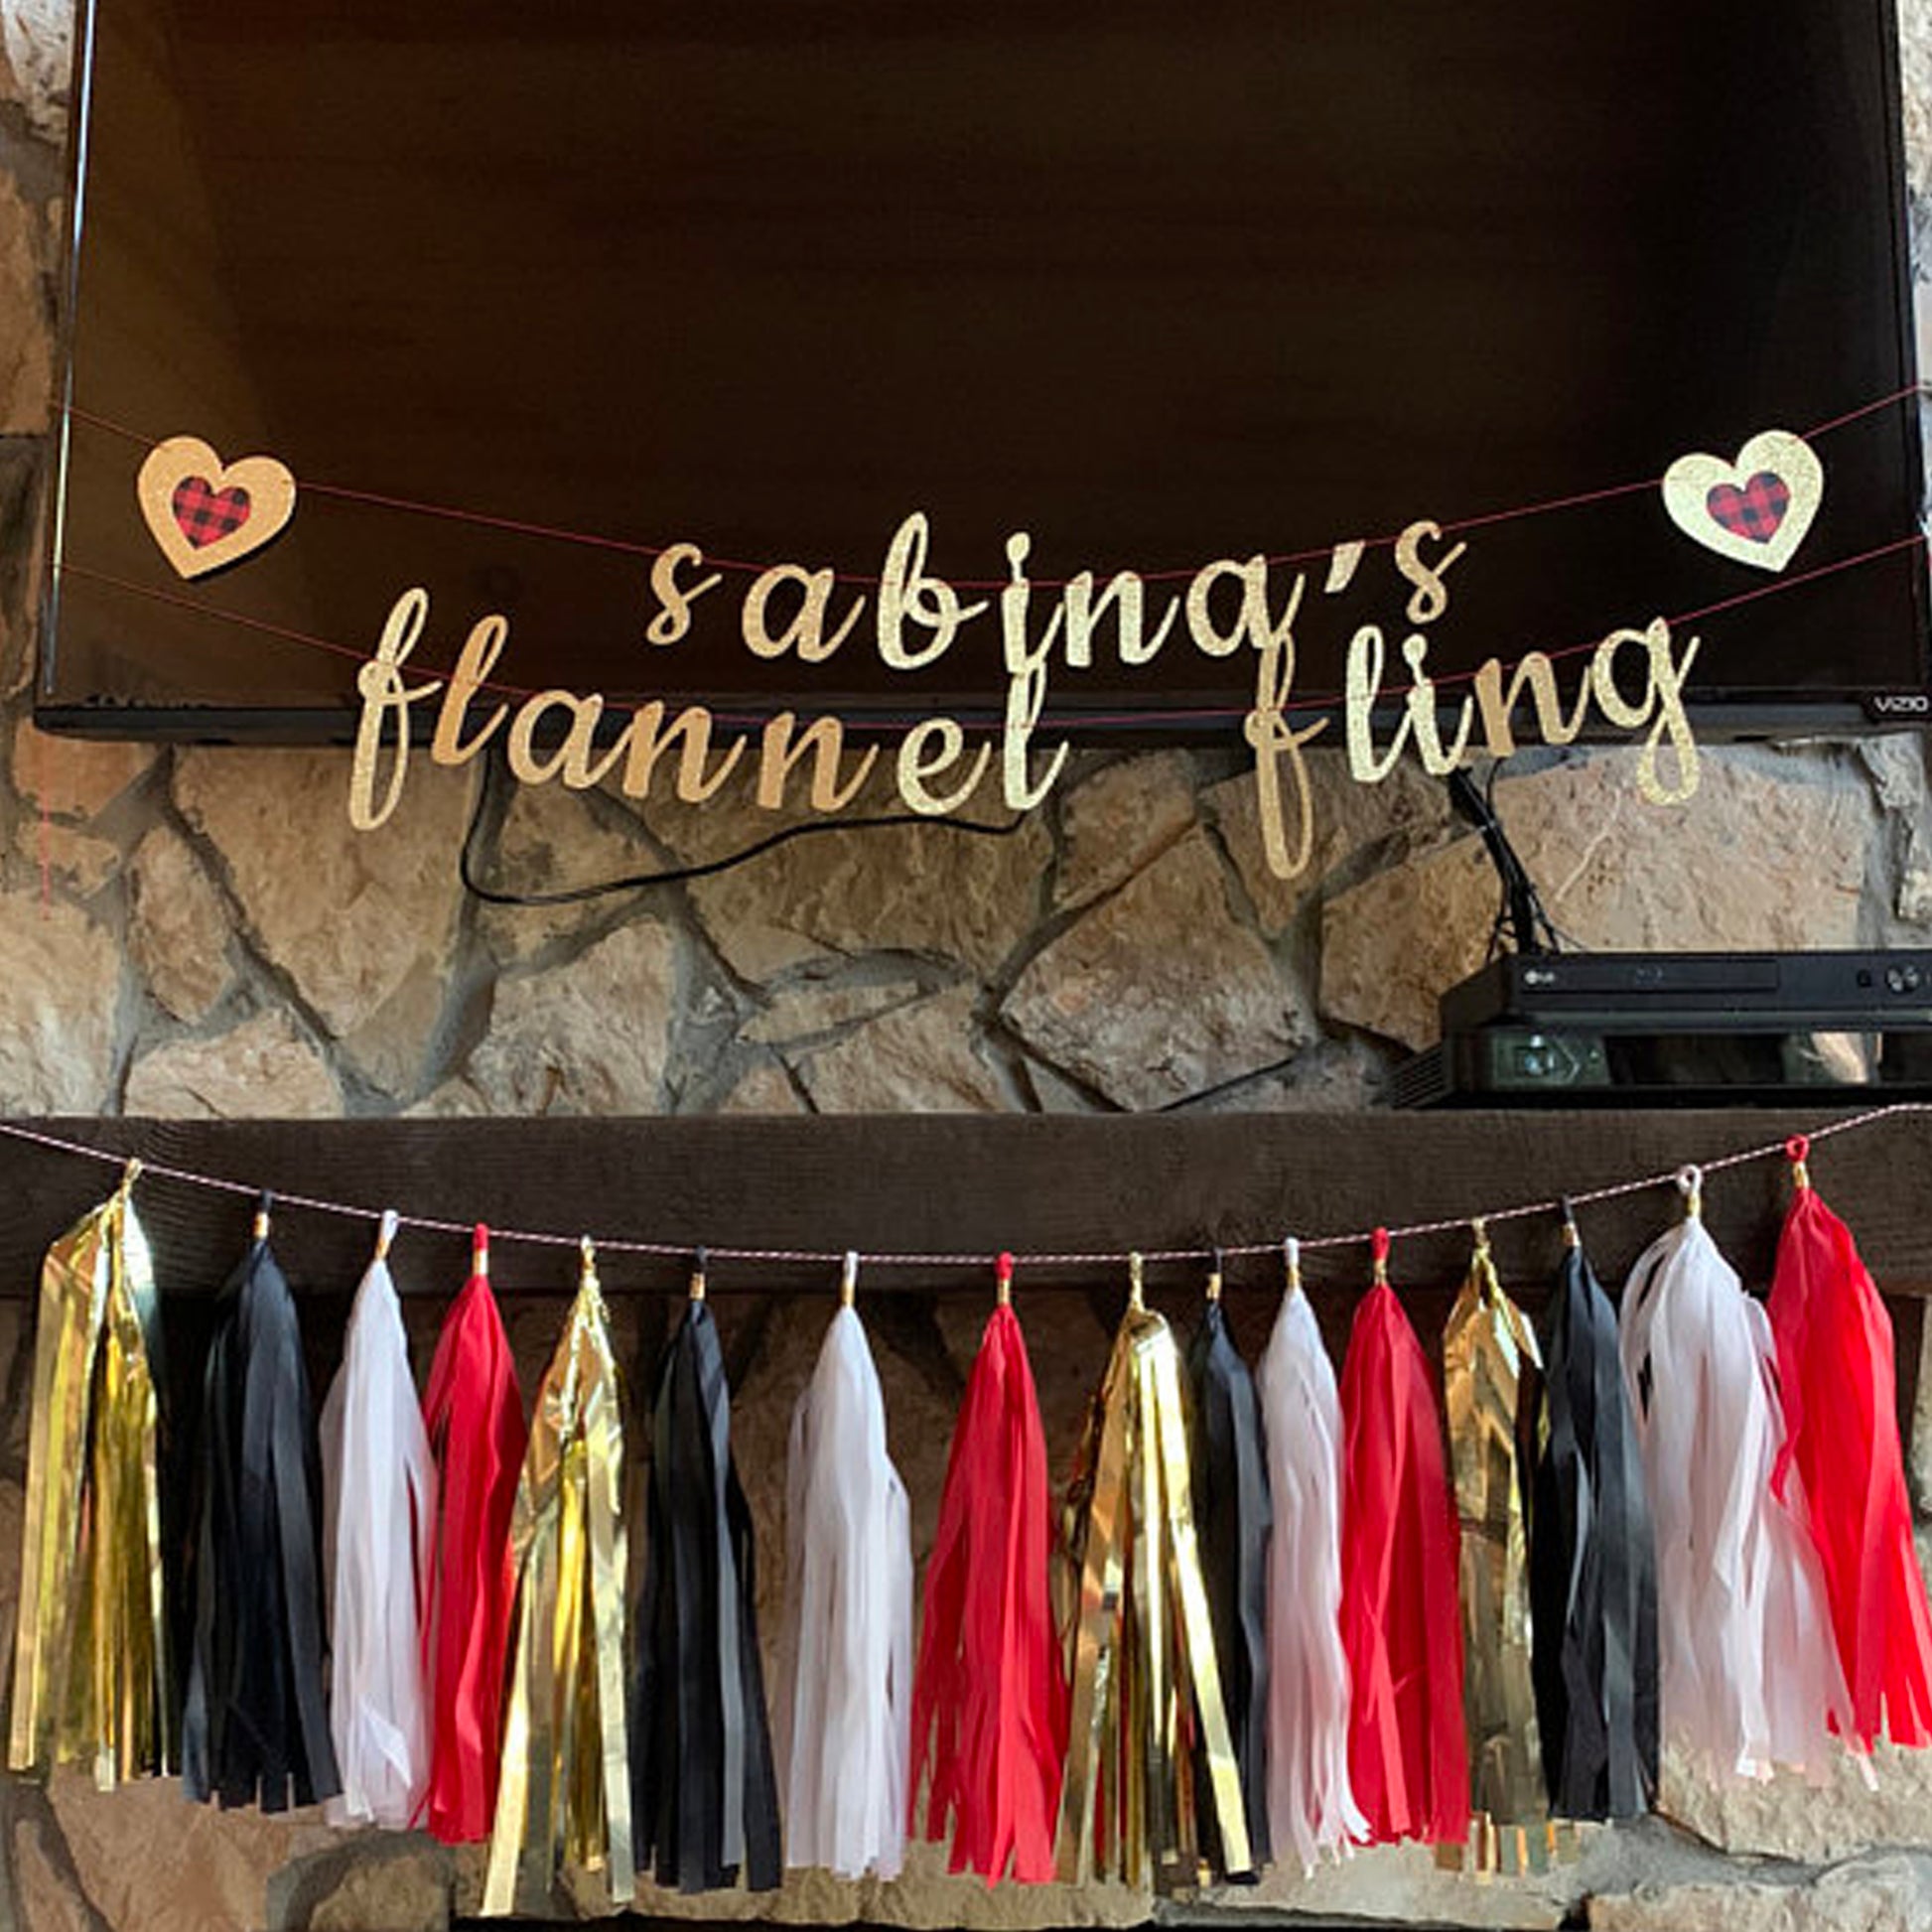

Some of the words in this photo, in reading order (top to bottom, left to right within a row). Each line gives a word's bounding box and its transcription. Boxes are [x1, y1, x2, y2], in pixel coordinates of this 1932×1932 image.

[644, 510, 1466, 675] sabina's
[348, 587, 1070, 831] flannel
[1244, 616, 1701, 880] fling
